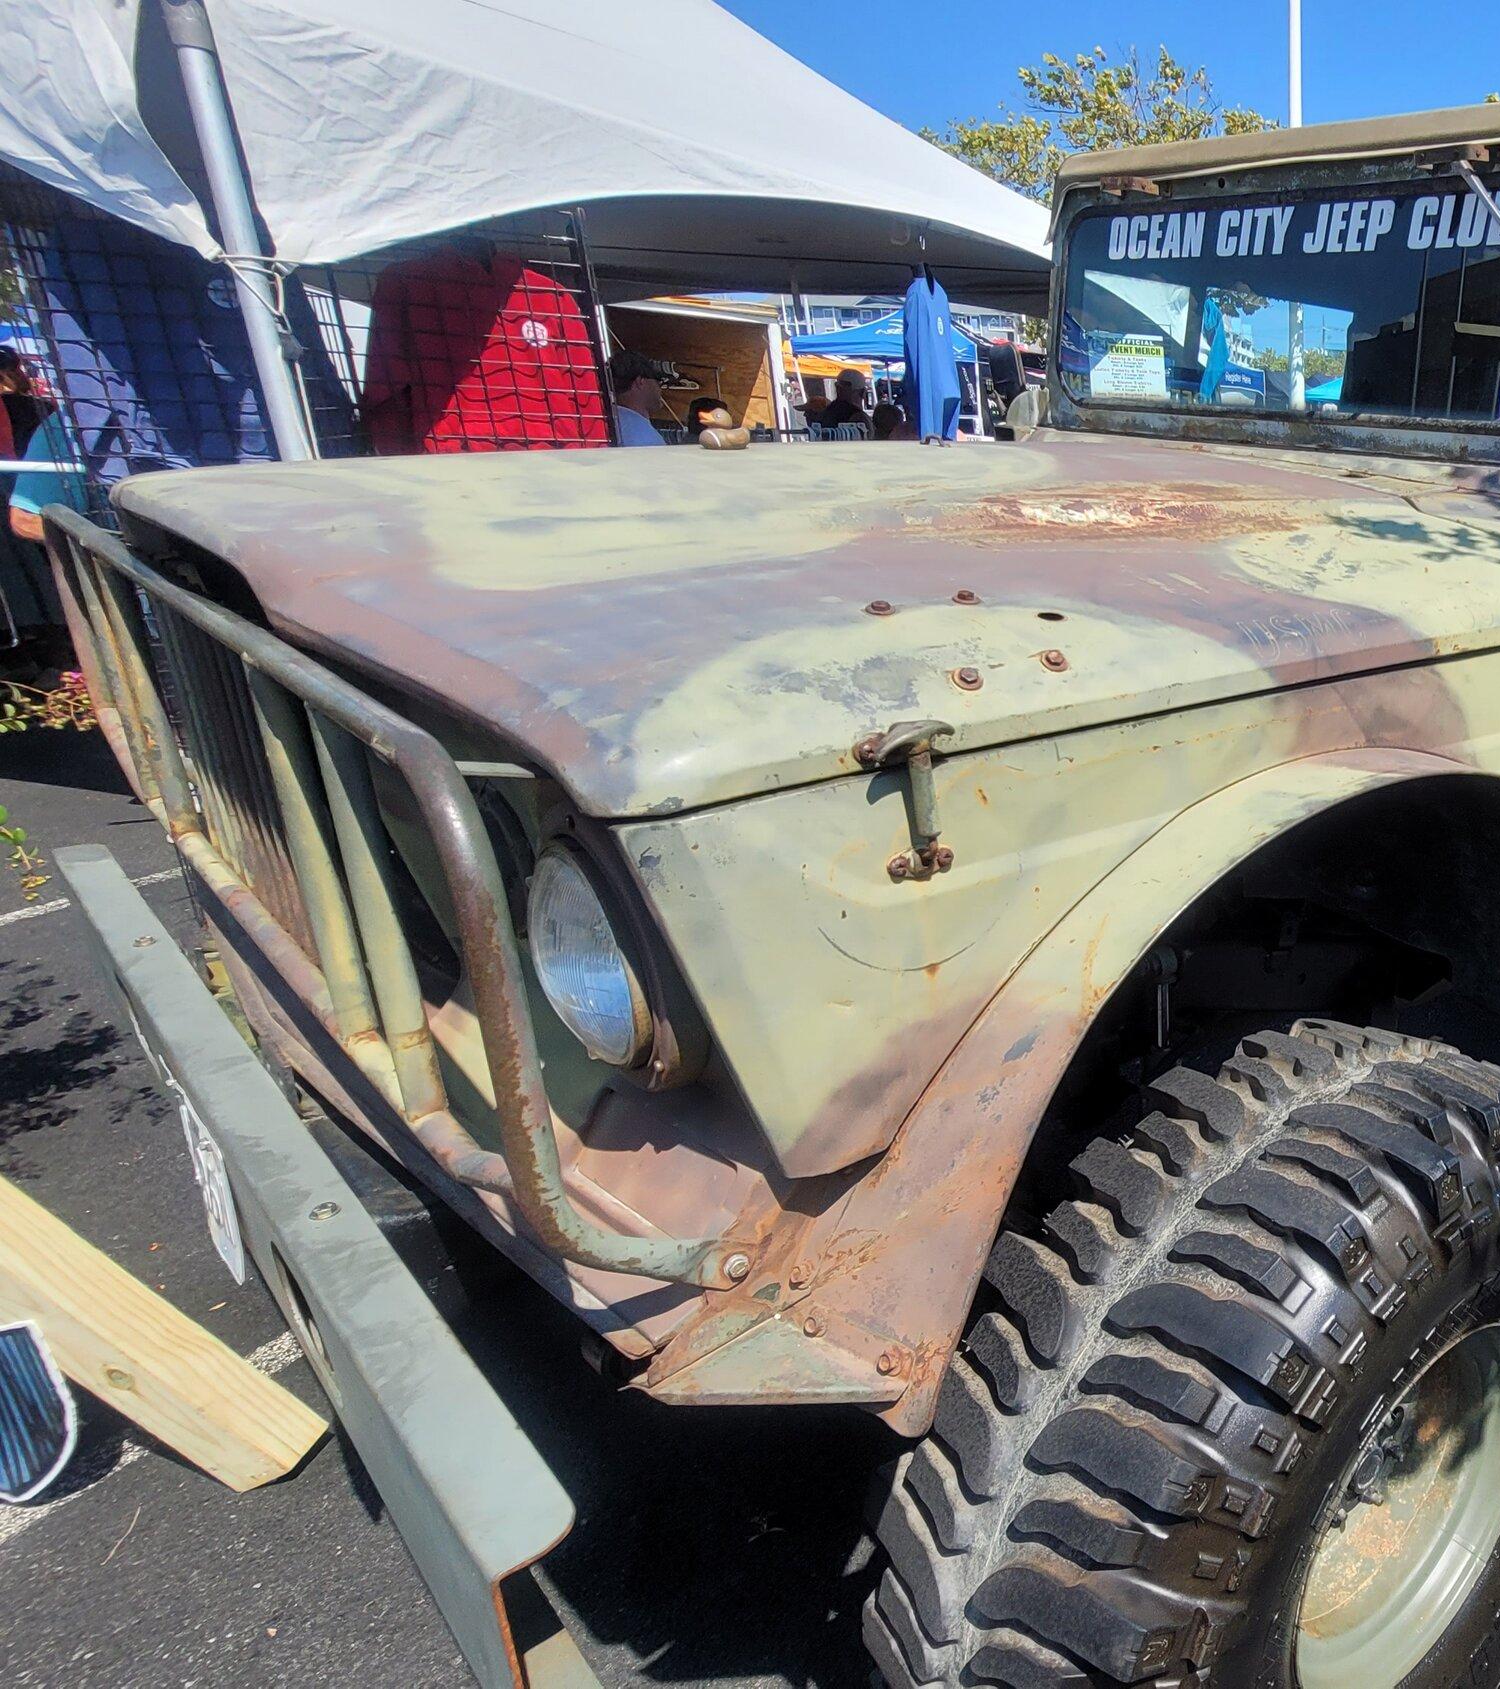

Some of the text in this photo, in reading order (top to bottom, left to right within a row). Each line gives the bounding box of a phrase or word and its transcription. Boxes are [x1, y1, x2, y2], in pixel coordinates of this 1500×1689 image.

[1108, 211, 1206, 260] OCEAN
[1215, 205, 1295, 256] CITY
[1302, 199, 1396, 254] JEEP
[1110, 346, 1161, 356] EVENT MERCH
